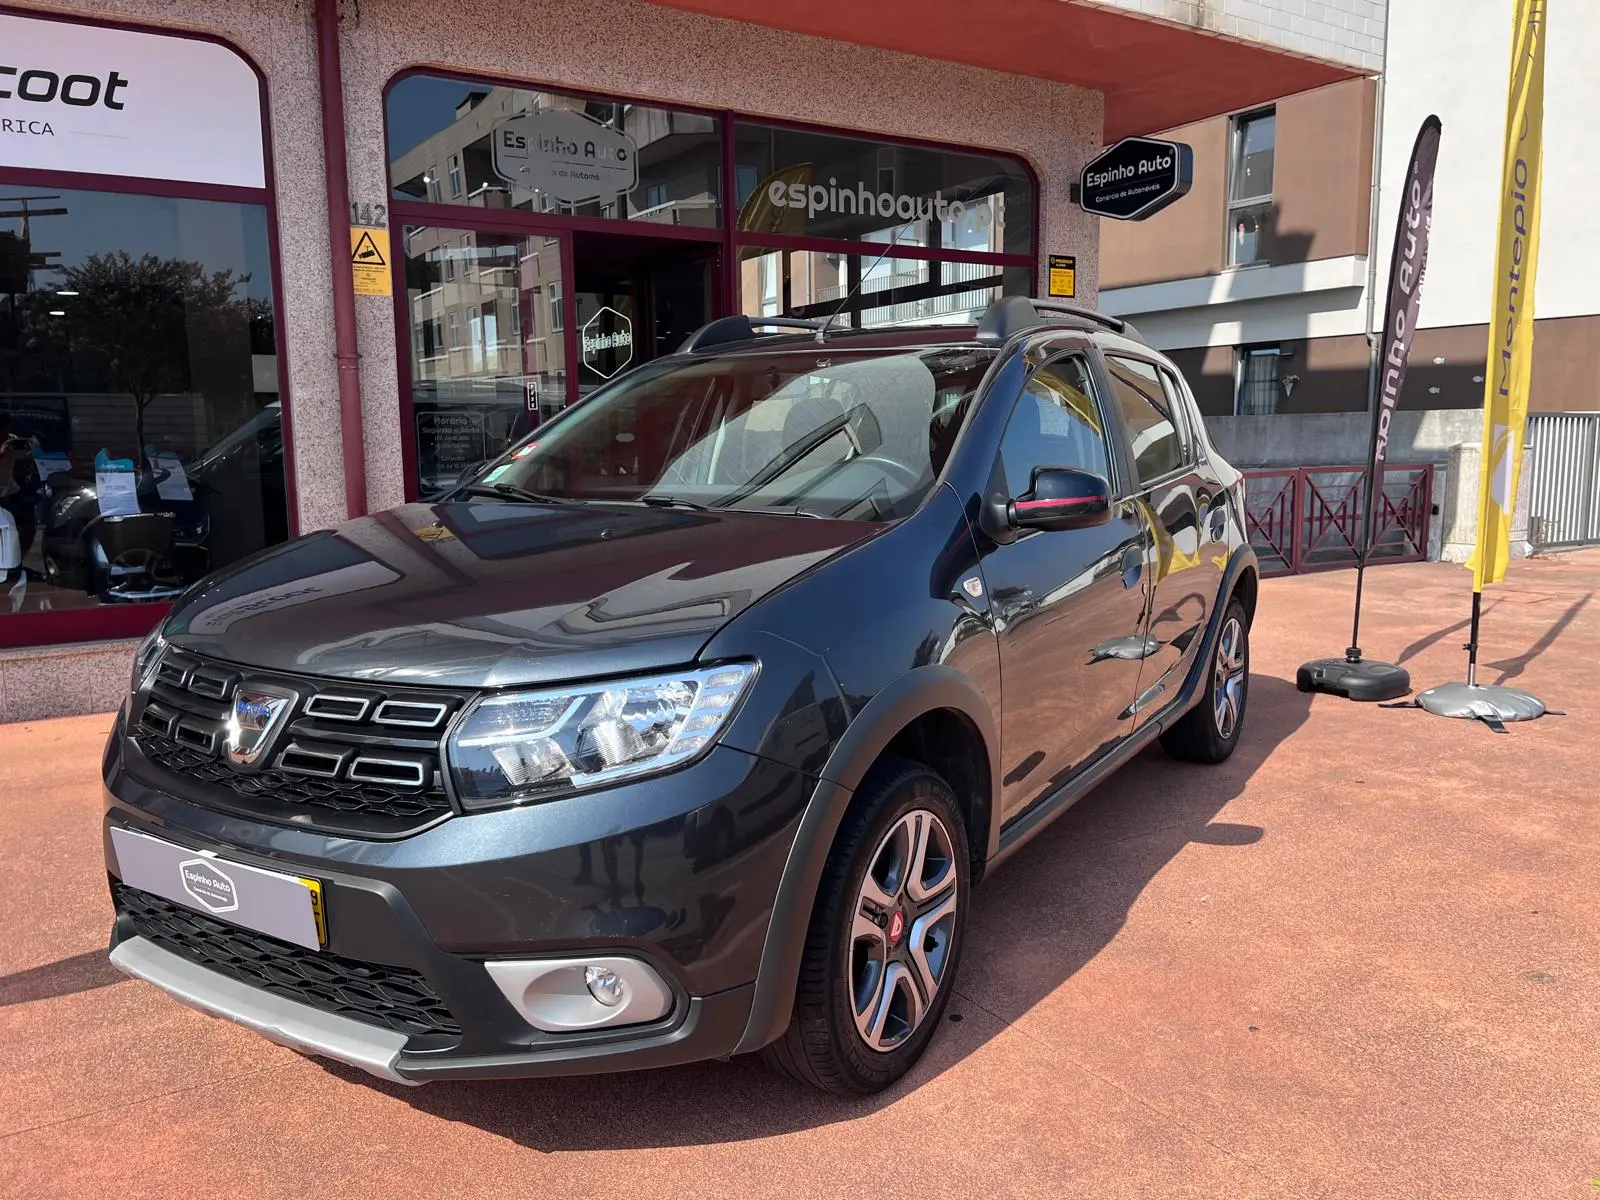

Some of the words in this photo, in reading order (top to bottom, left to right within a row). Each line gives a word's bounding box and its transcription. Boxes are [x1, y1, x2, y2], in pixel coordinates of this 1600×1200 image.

[1086, 164, 1135, 188] Espinho
[1138, 155, 1172, 174] Auto
[351, 202, 386, 227] 142
[1400, 179, 1421, 295] Auto
[1499, 158, 1528, 396] Montepio
